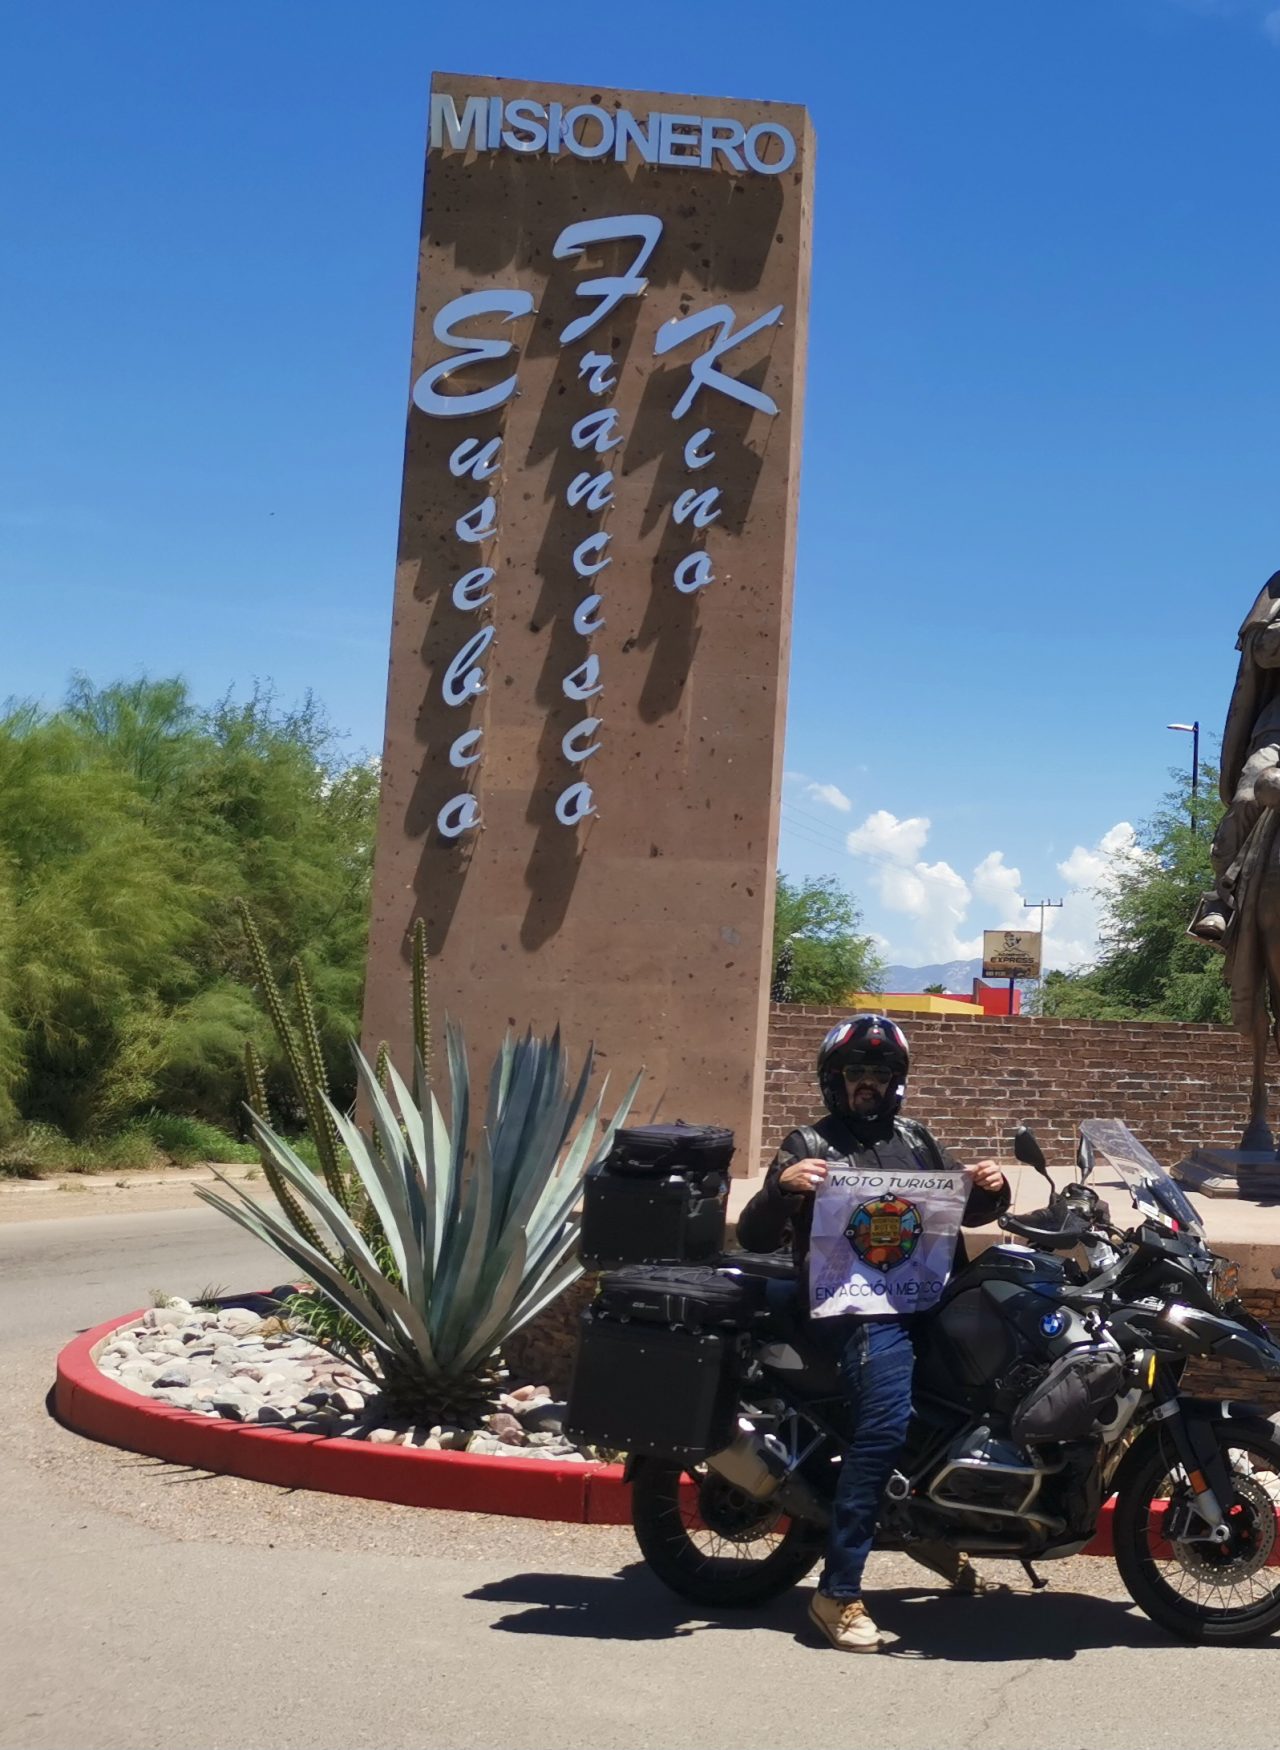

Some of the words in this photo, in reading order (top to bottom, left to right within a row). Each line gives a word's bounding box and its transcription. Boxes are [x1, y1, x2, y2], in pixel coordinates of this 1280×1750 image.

[429, 93, 798, 176] MISIONERO
[653, 303, 785, 594] Kino
[552, 213, 664, 826] Francisco
[990, 956, 1034, 964] EXPRESS
[830, 1175, 884, 1187] MOTO
[889, 1177, 954, 1190] TURISTA
[815, 1286, 835, 1300] EN
[838, 1280, 893, 1298] ACCIÓN
